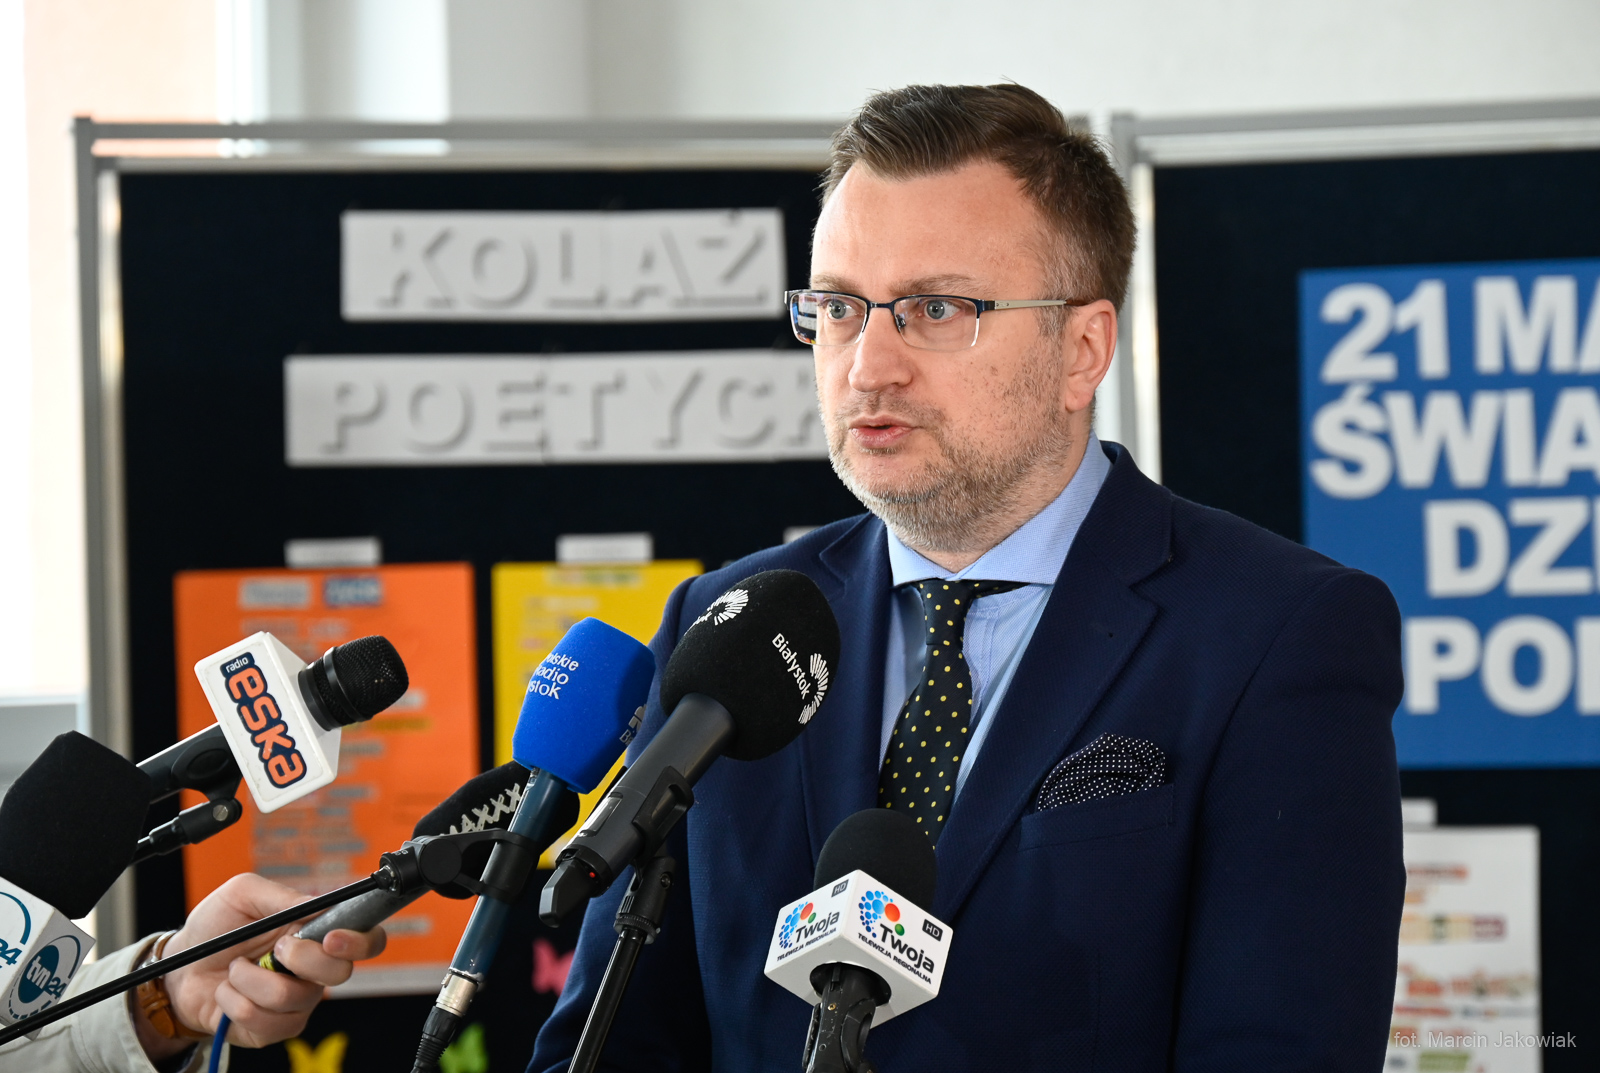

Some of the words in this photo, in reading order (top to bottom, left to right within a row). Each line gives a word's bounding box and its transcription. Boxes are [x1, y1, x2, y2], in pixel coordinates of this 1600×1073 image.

[1320, 278, 1450, 383] 21
[1424, 494, 1600, 598] DZ
[225, 656, 250, 674] radio
[771, 632, 812, 700] Białystok
[228, 666, 305, 786] eska
[833, 881, 848, 895] HD
[777, 944, 804, 962] TELEWIZJA
[805, 927, 837, 949] REGIONALNA
[795, 911, 840, 944] Twoja
[879, 923, 935, 974] Twoja
[924, 921, 941, 939] HD
[26, 955, 67, 1000] tvn24
[857, 932, 892, 960] TELEWIZJA
[893, 955, 932, 985] REGIONALNA
